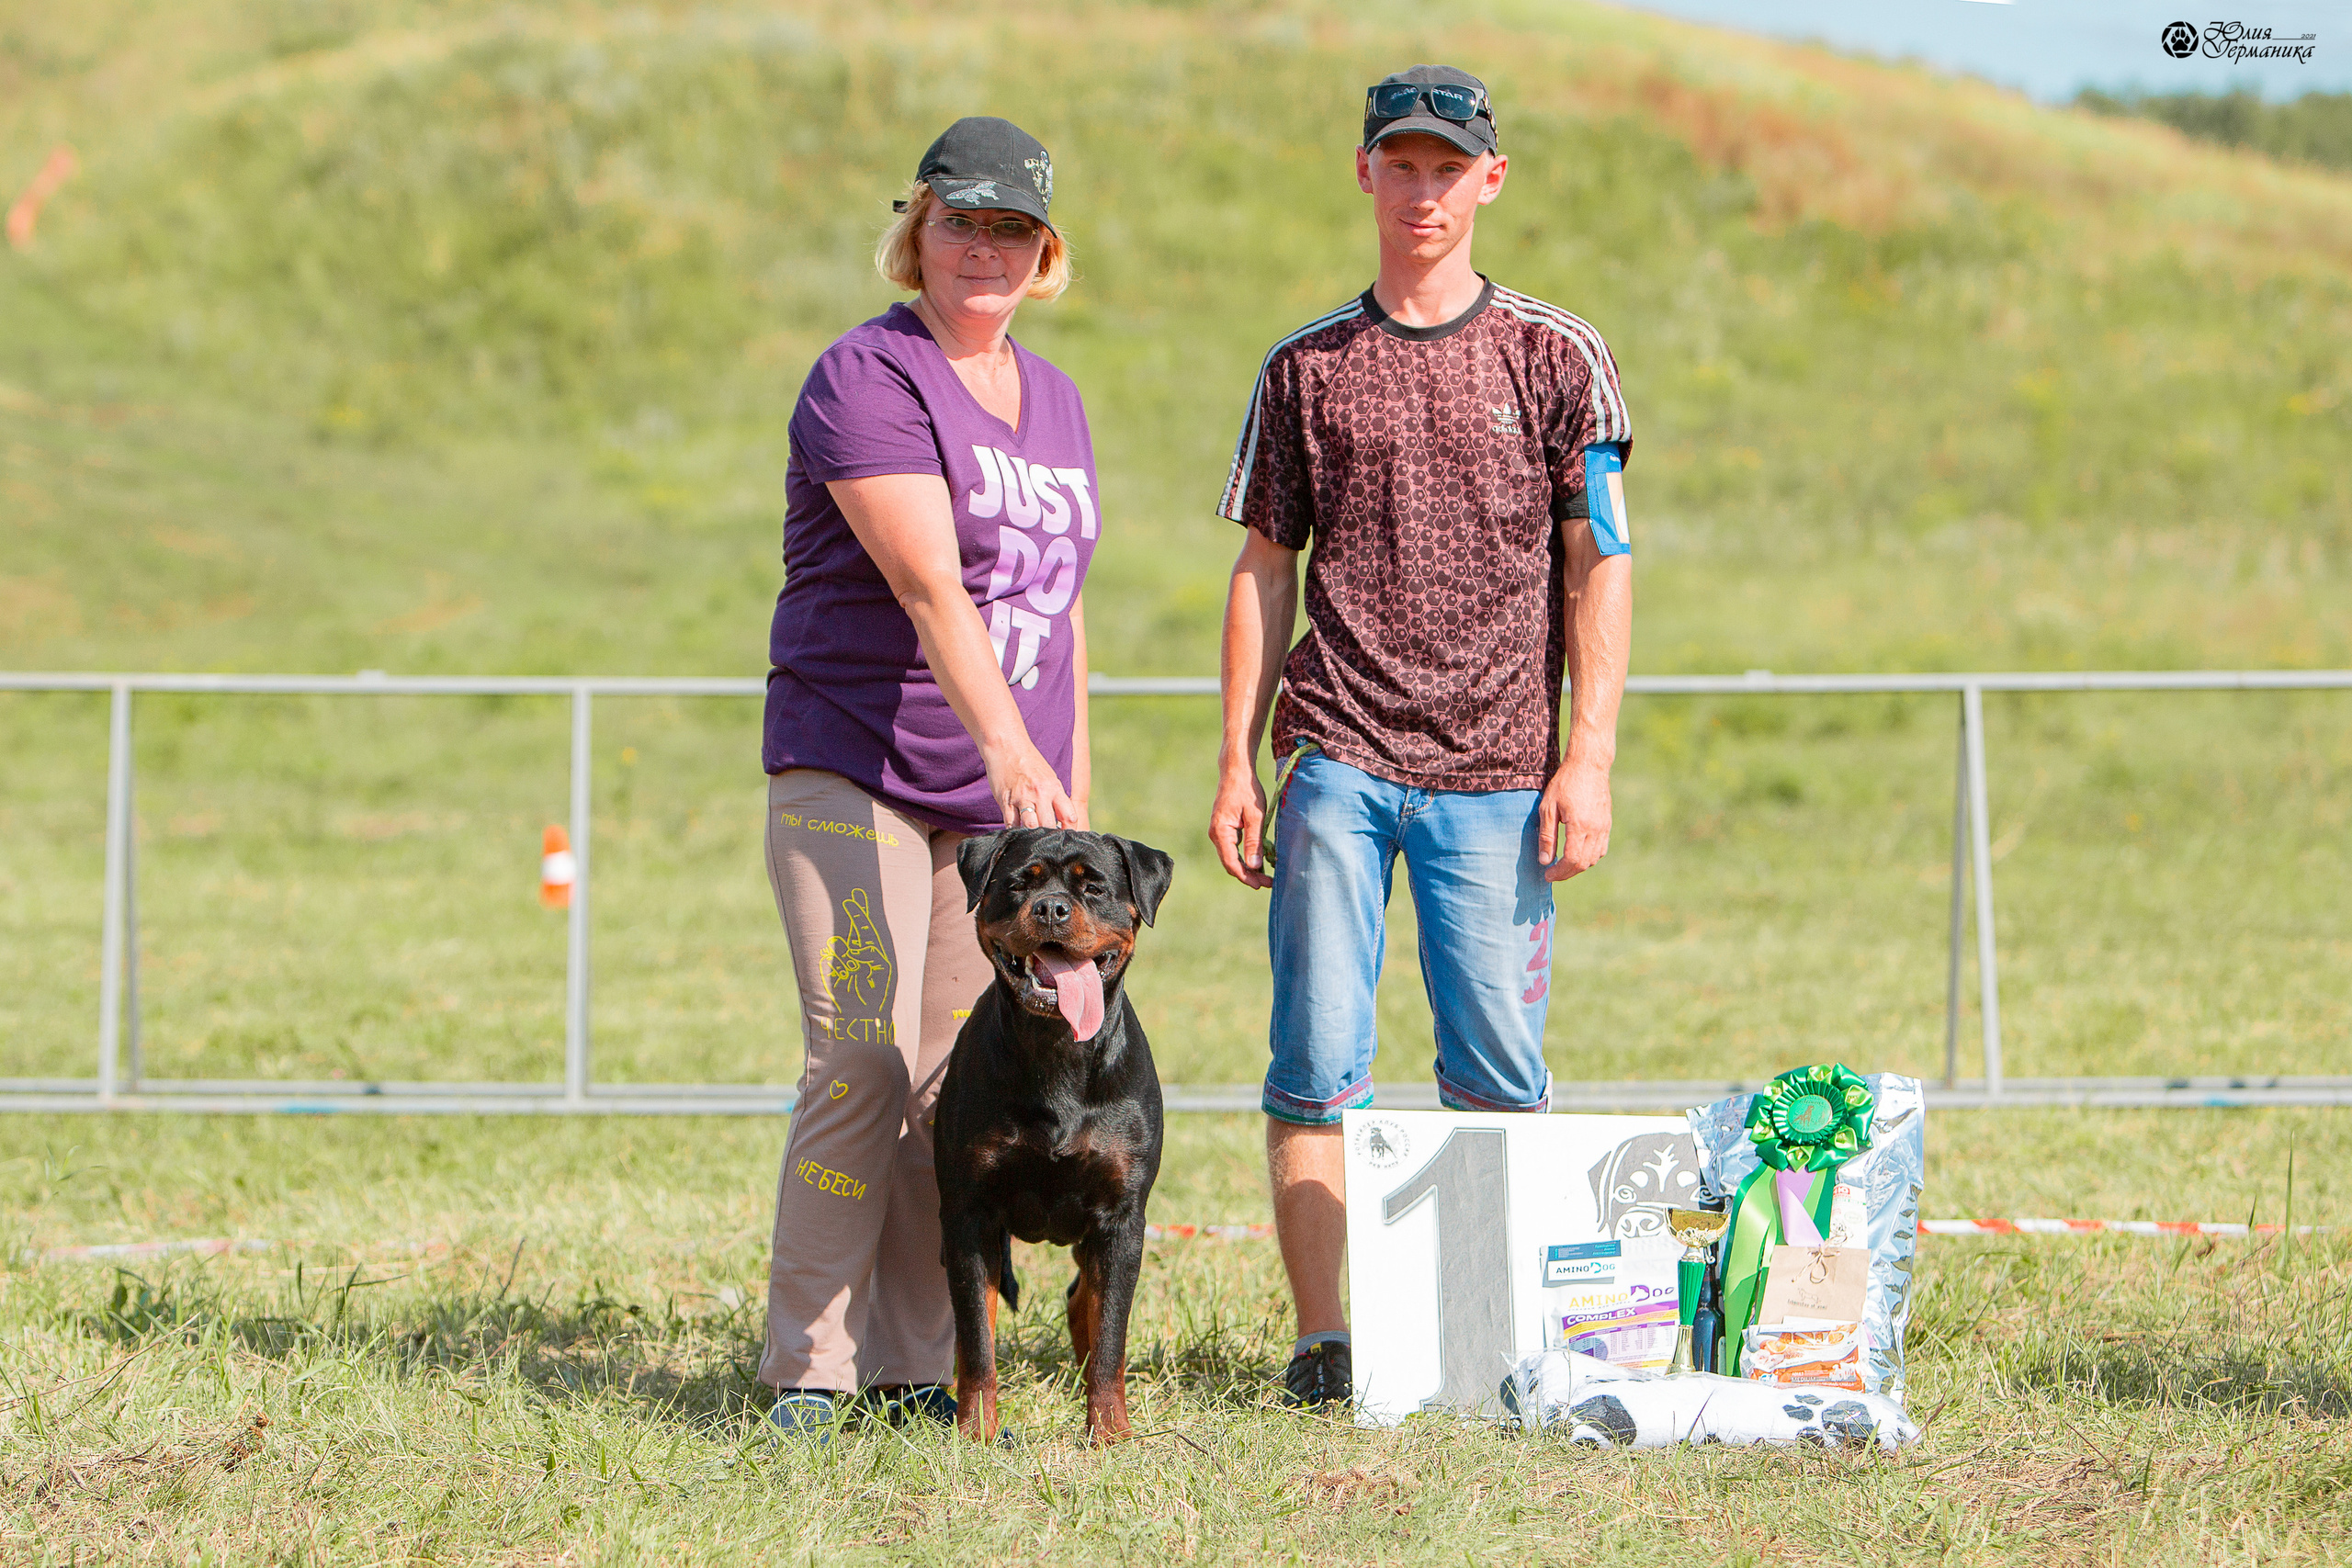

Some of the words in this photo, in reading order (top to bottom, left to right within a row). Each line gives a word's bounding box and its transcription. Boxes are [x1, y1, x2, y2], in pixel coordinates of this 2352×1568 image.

[968, 444, 1097, 540] JUST
[986, 525, 1078, 615] DO
[988, 599, 1051, 691] IT.
[808, 818, 899, 846] сможешь
[820, 1017, 897, 1045] ЧЕСТНО
[1382, 1127, 1518, 1417] 1
[1566, 1307, 1636, 1325] COMPLEX
